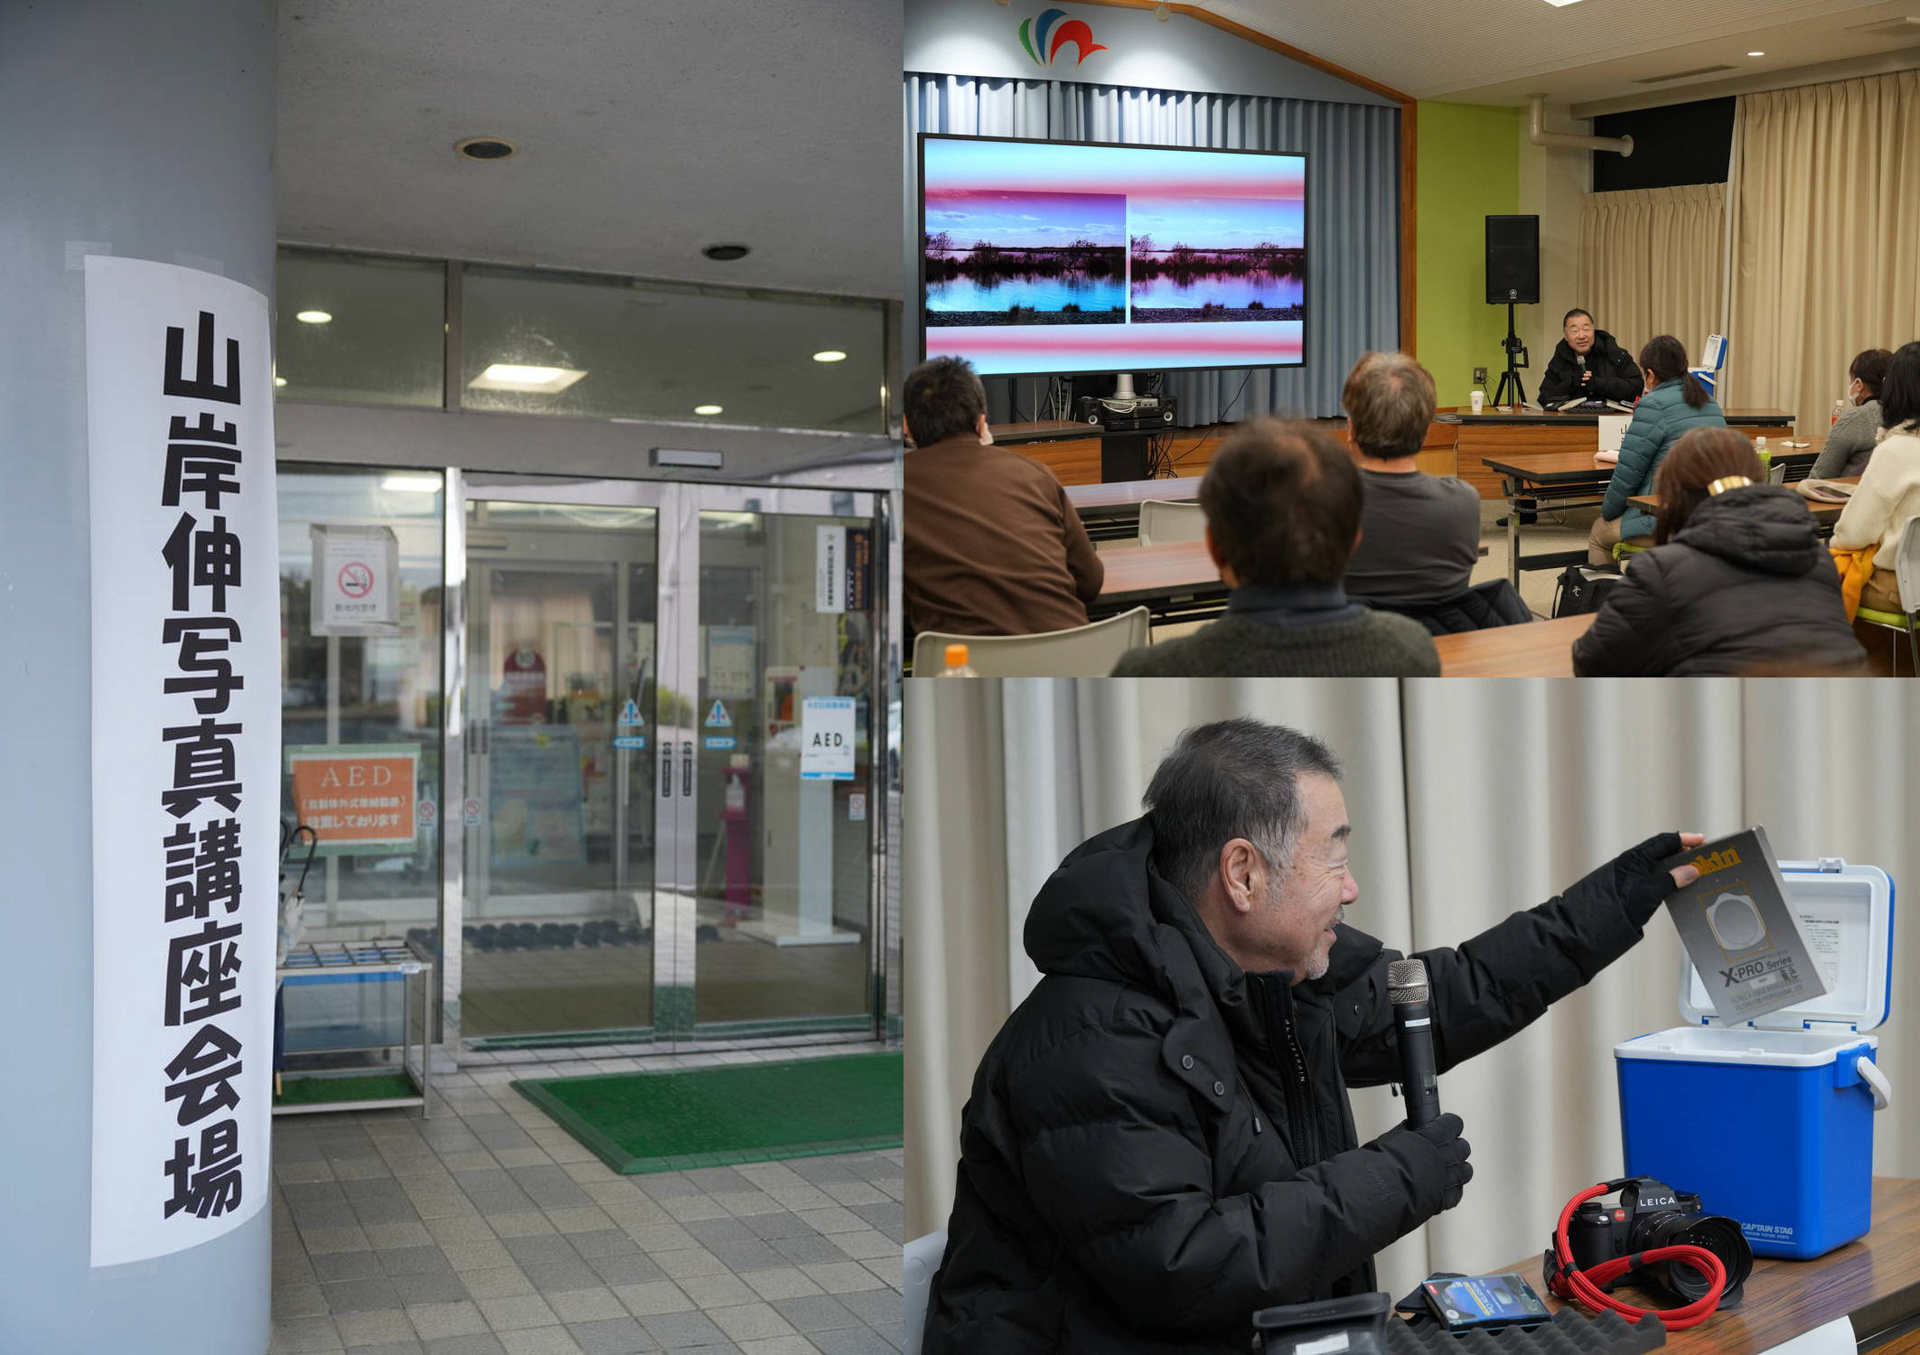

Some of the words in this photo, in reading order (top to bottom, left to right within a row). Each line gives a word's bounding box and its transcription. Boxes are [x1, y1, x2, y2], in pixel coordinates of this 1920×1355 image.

[812, 732, 843, 747] AED
[163, 311, 245, 1220] 山岸伸写真講座会場
[320, 765, 392, 788] AED
[1766, 956, 1793, 970] Series
[1640, 1196, 1676, 1207] LEICA
[1741, 1223, 1774, 1234] CAPTAIN
[1774, 1226, 1793, 1236] STAG
